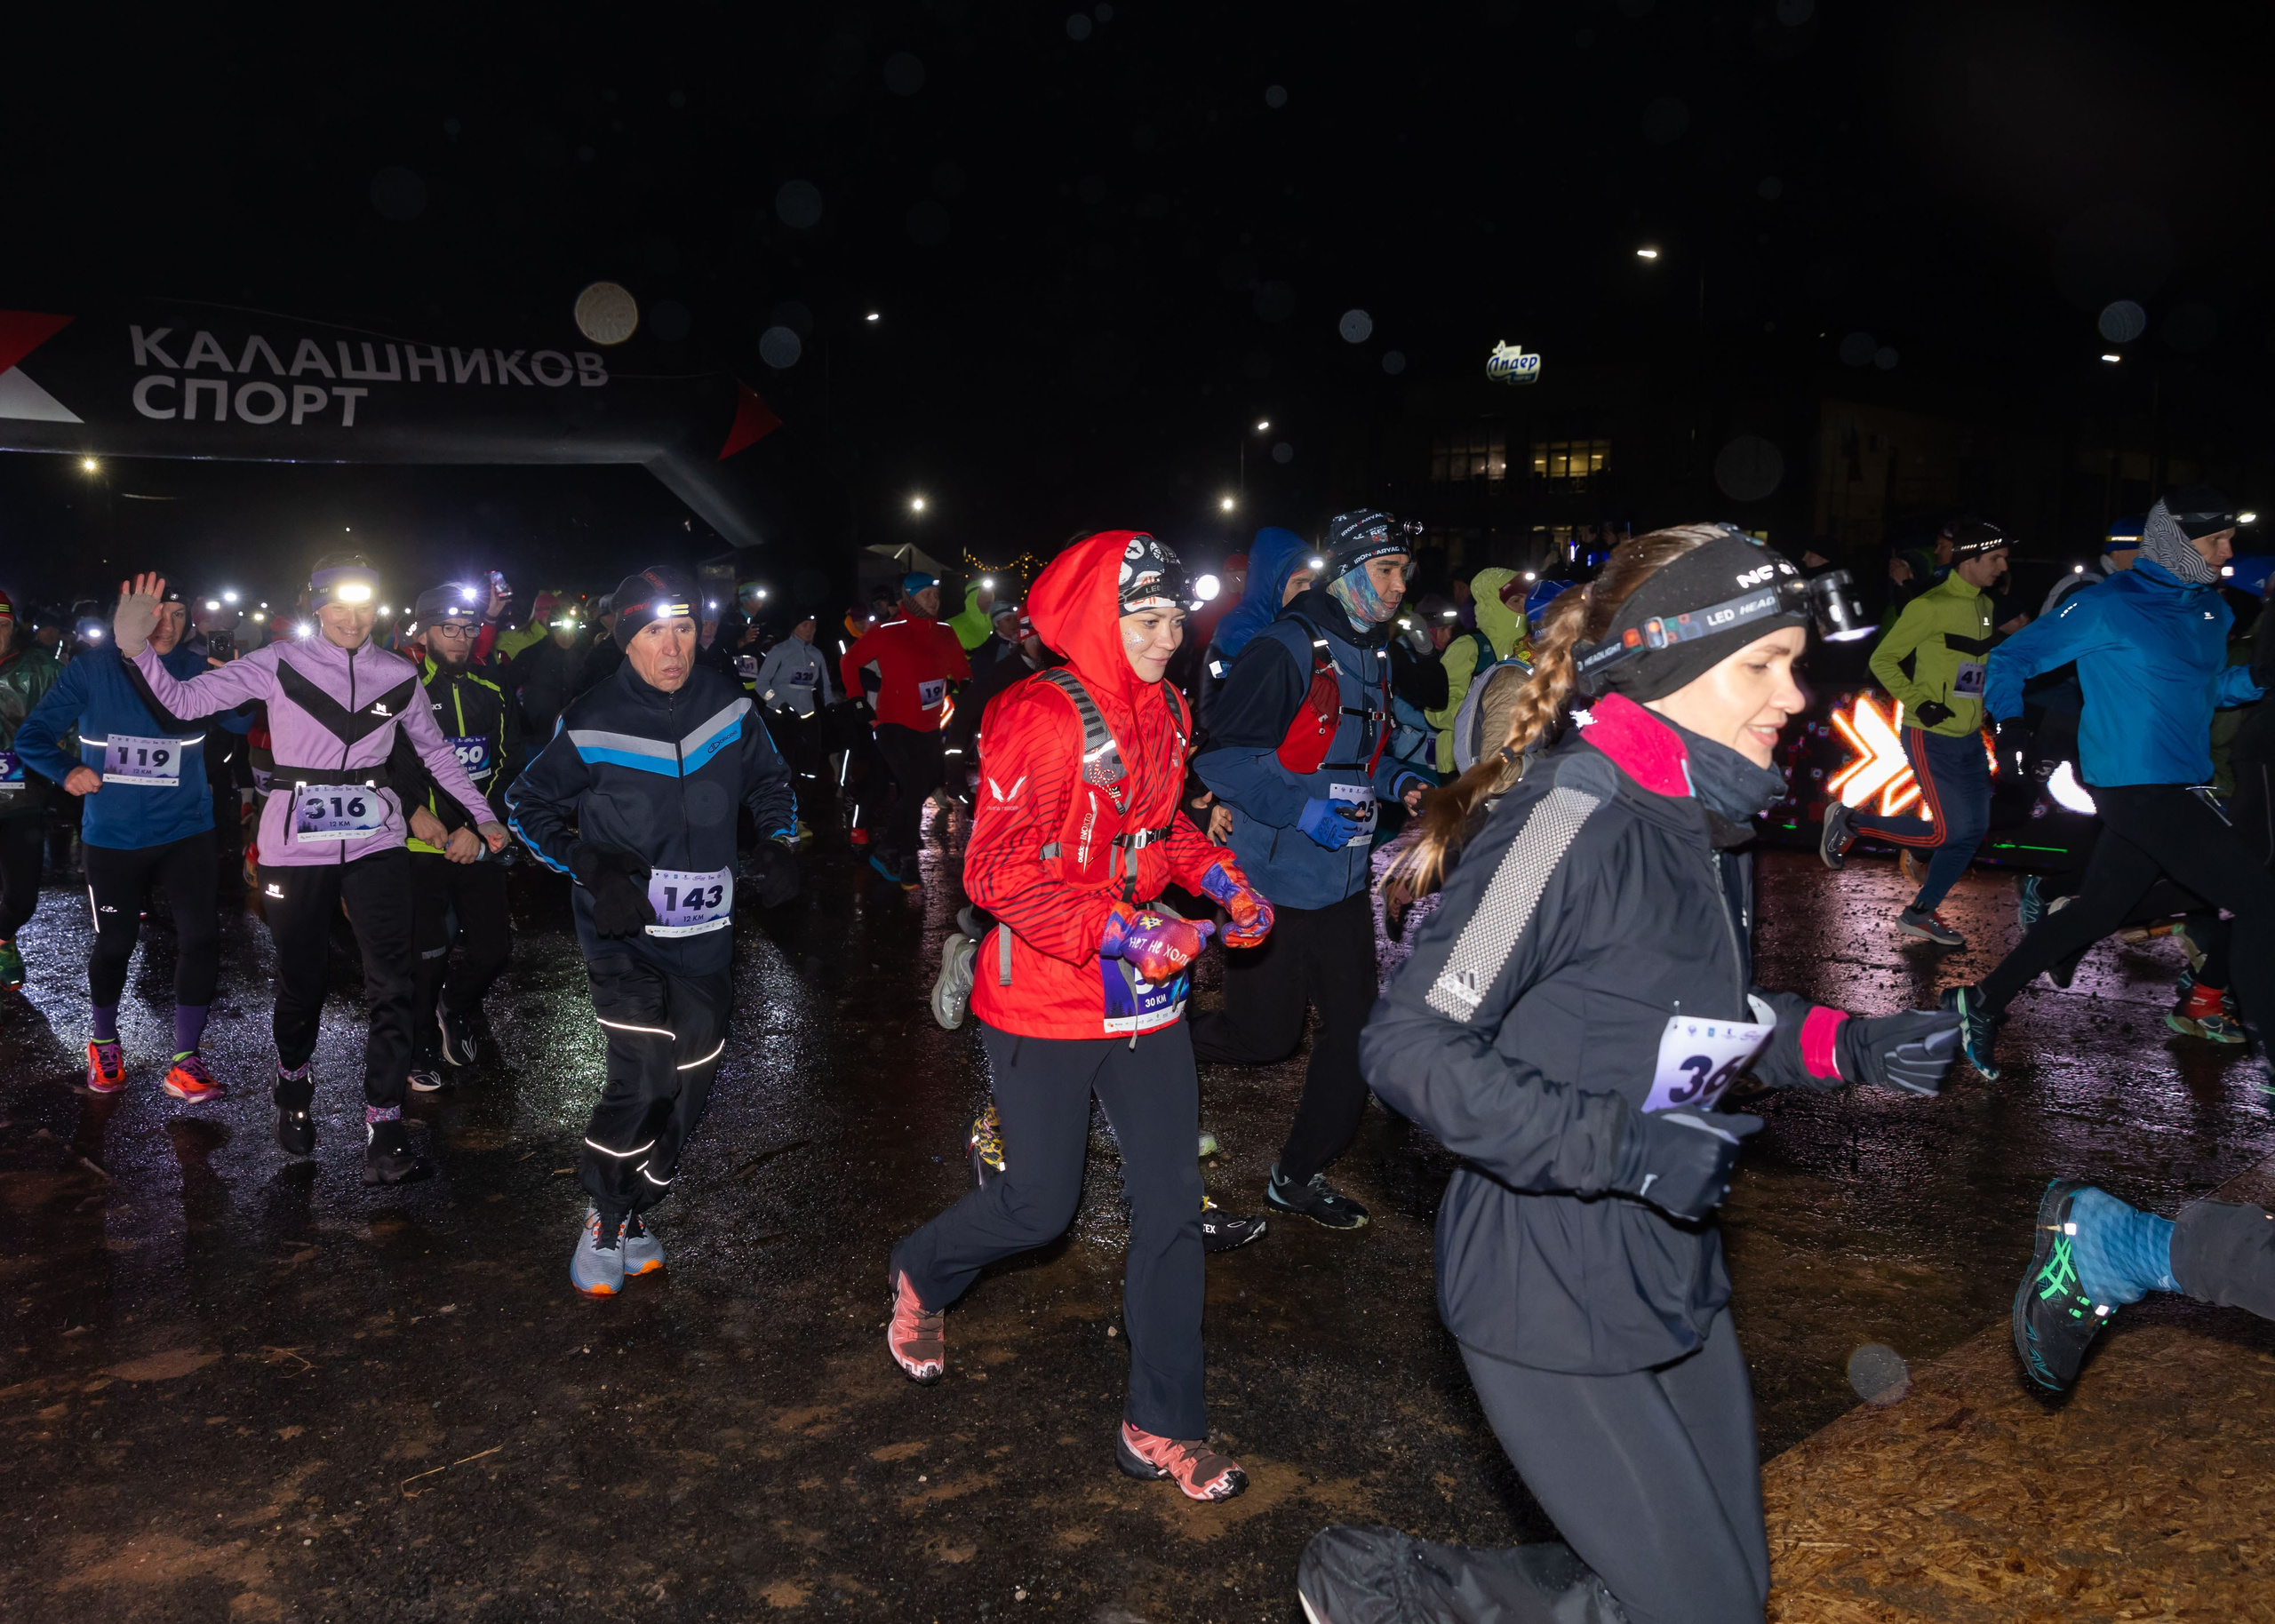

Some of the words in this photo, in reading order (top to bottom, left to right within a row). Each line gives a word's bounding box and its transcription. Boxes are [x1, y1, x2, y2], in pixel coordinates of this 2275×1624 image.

[129, 324, 610, 387] КАЛАШНИКОВ
[1488, 356, 1538, 373] Лидер
[132, 374, 369, 427] СПОРТ
[1706, 609, 1735, 627] LED
[1738, 595, 1776, 616] HEAD
[1584, 641, 1622, 667] HEADLIGHT
[1961, 671, 1985, 685] 41
[925, 686, 943, 698] 19
[117, 746, 171, 768] 119
[305, 796, 367, 819] 316
[1356, 800, 1375, 823] 25
[1080, 812, 1093, 840] INOXTO
[663, 884, 724, 912] 143
[1145, 998, 1155, 1008] 30
[1156, 993, 1167, 1005] KM
[1668, 1055, 1747, 1103] 36
